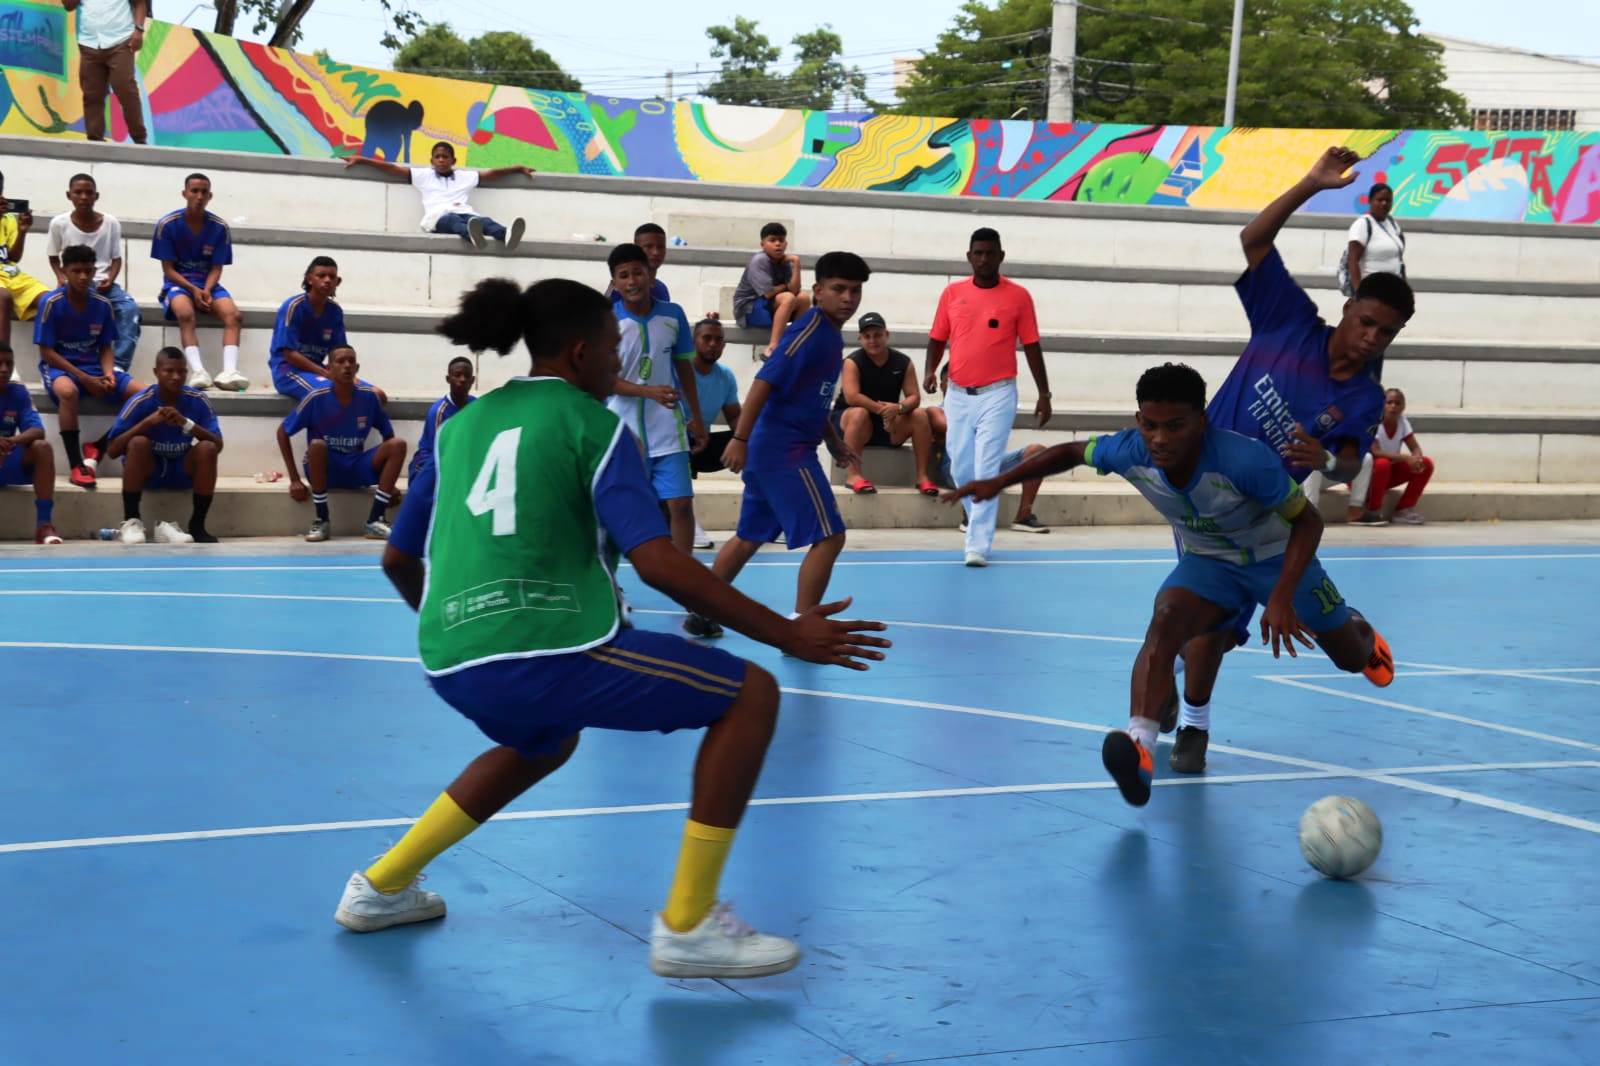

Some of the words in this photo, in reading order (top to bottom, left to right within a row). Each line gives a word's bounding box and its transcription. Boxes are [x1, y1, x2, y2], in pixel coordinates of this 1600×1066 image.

[1247, 398, 1270, 422] FLY
[1253, 372, 1303, 444] Emira
[465, 427, 521, 535] 4
